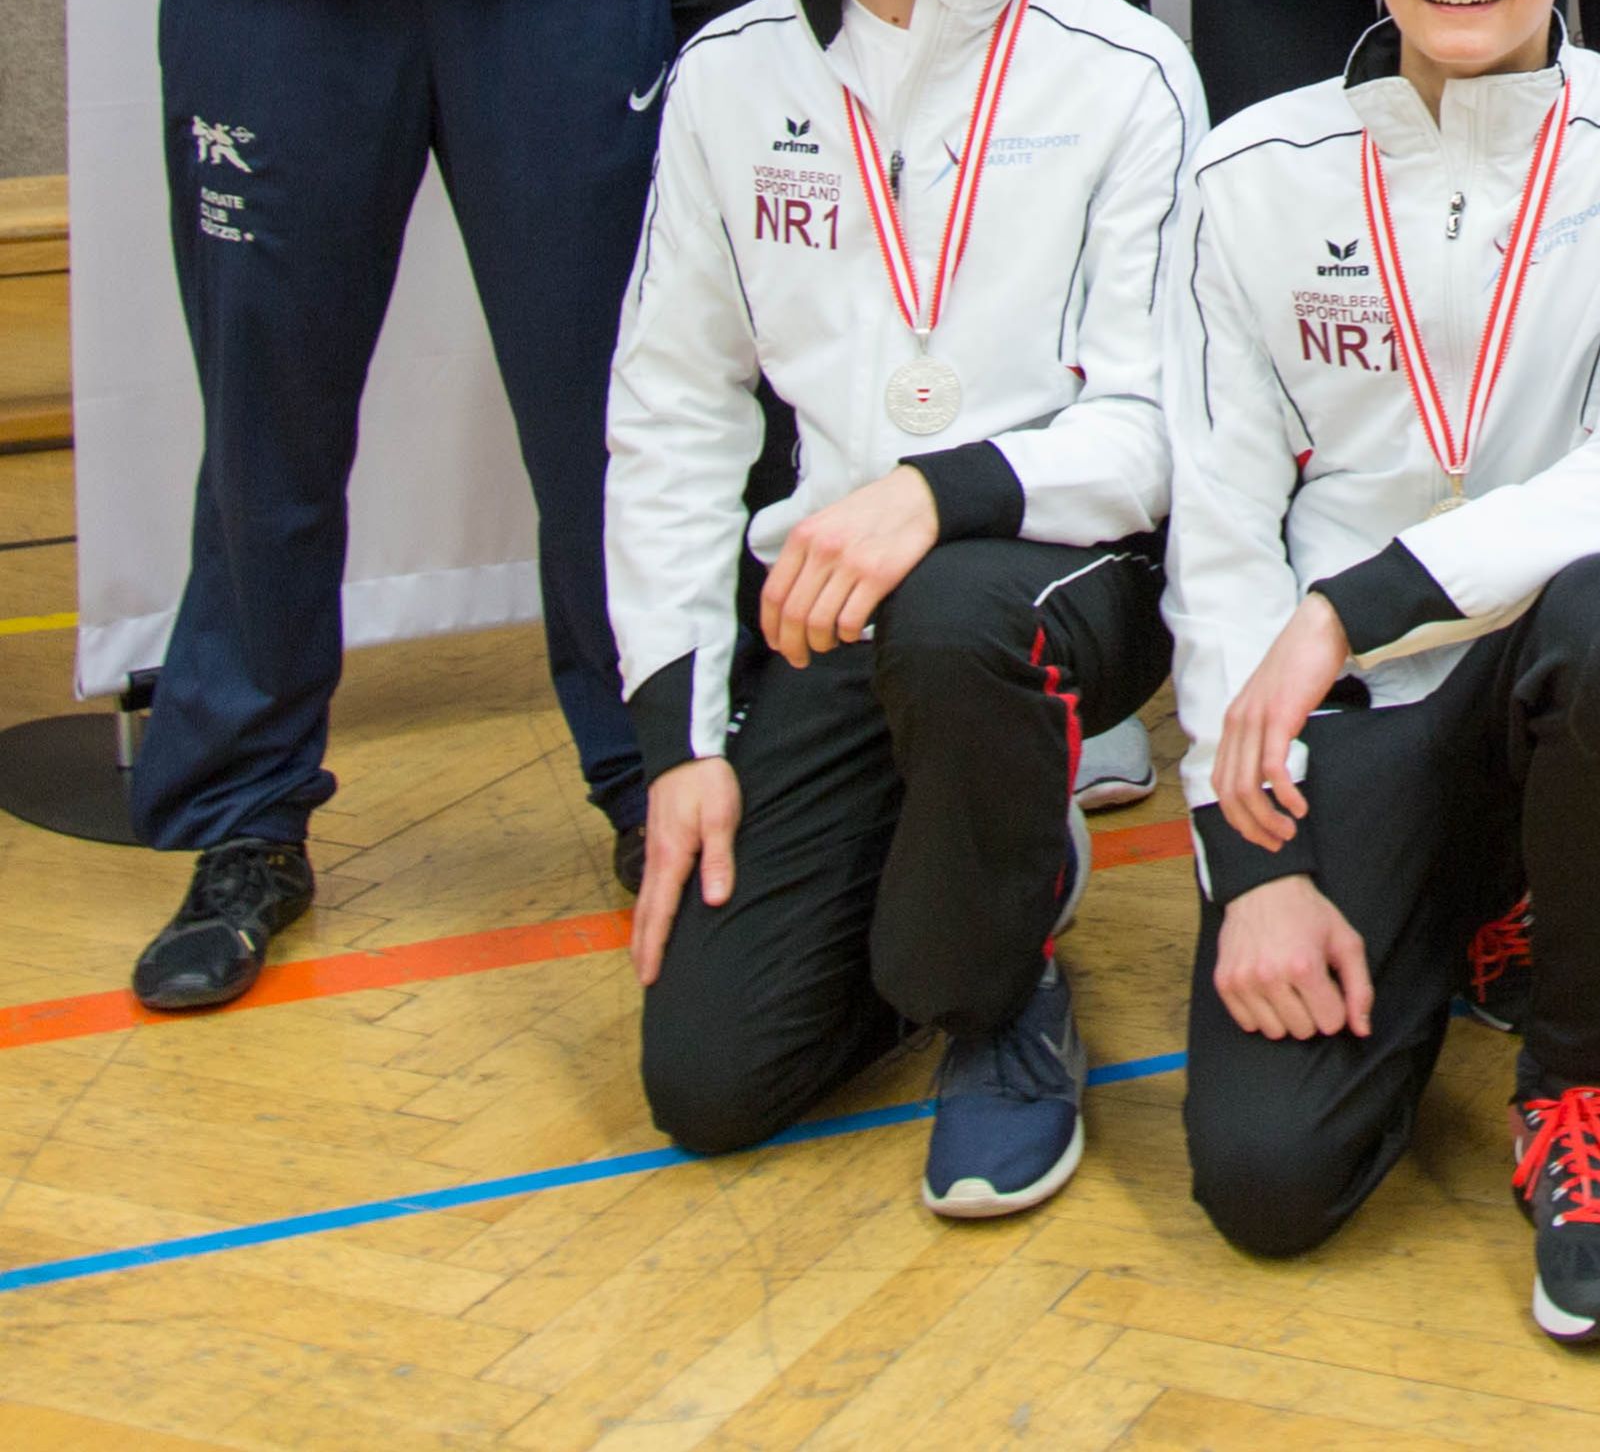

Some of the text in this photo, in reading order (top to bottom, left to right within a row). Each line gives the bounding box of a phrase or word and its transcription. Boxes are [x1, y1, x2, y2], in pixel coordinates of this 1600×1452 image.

[773, 140, 819, 154] erima
[755, 179, 840, 202] SPORTLAND
[755, 194, 839, 250] NR.1
[1317, 264, 1370, 277] erima
[1298, 319, 1399, 372] NR.1
